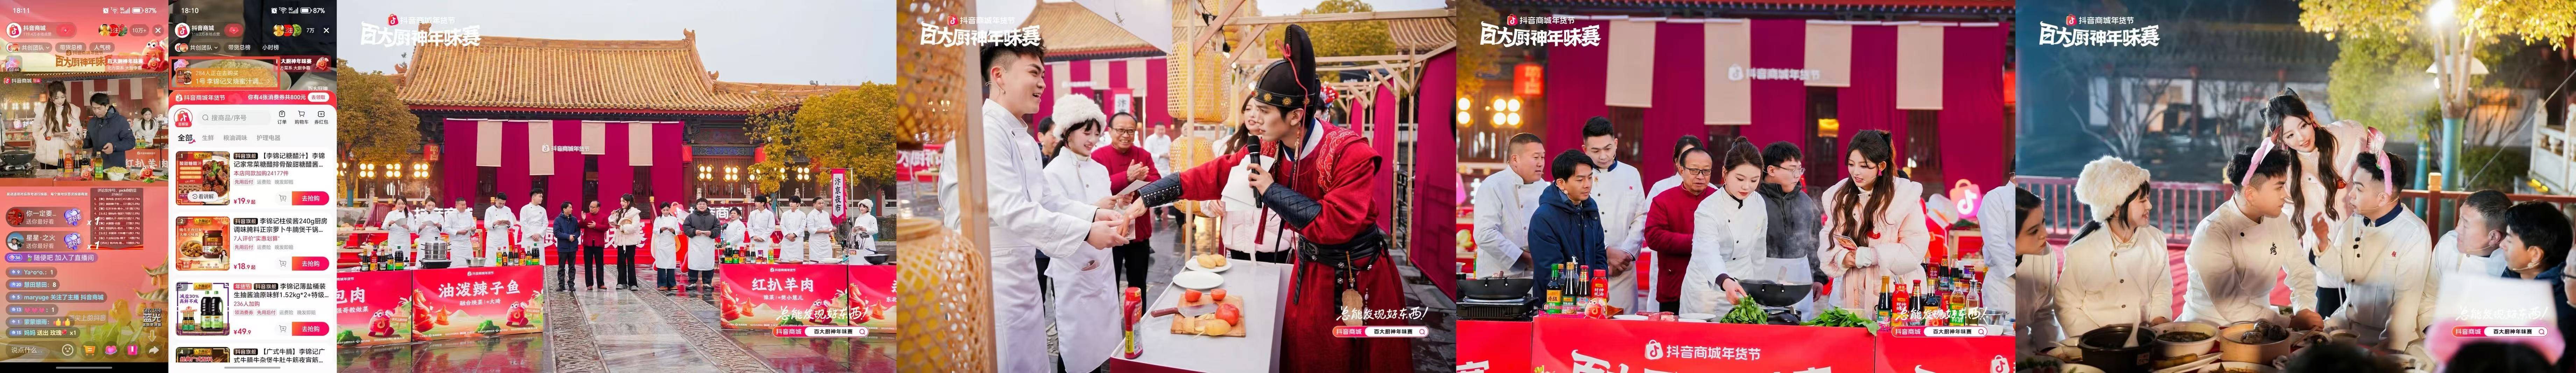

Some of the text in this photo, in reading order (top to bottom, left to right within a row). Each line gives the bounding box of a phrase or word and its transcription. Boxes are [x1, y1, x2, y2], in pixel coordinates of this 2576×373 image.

[55, 54, 113, 68] 百大厨神年味赛
[1745, 68, 1820, 80] 抖音商城年货节
[438, 279, 520, 298] 油泼辣子鱼
[752, 278, 814, 293] 红扒羊肉
[337, 306, 369, 314] 强哥教做菜
[143, 313, 161, 323] 蓝光
[1667, 345, 1761, 361] 抖音商城年货节
